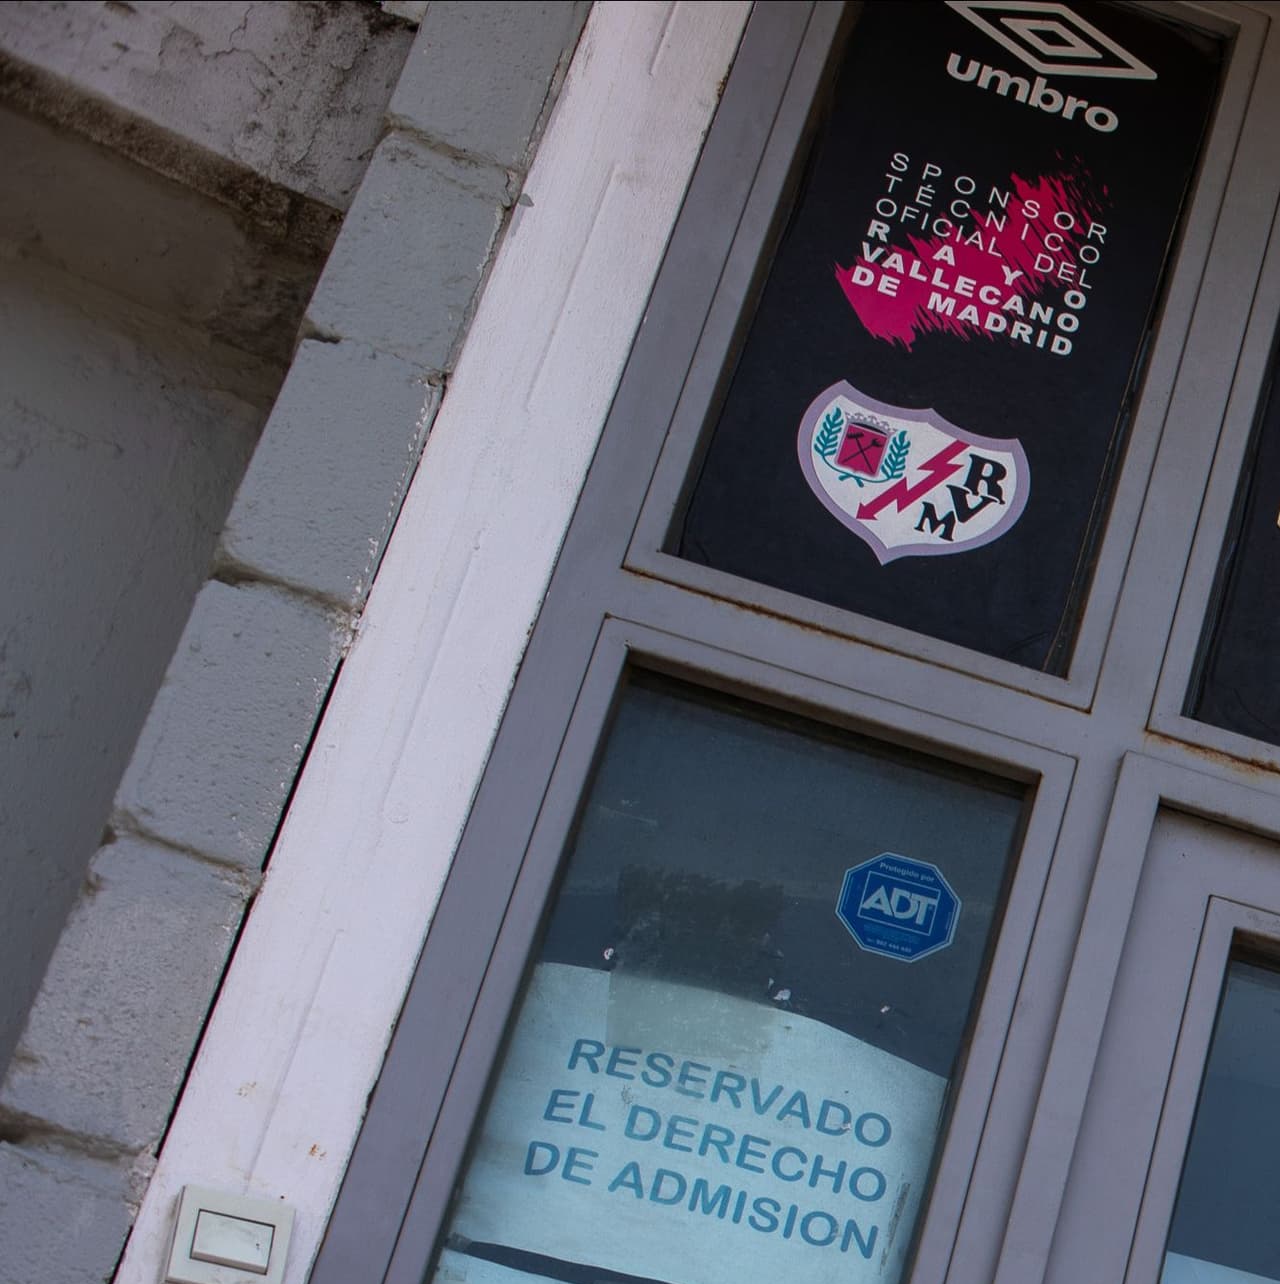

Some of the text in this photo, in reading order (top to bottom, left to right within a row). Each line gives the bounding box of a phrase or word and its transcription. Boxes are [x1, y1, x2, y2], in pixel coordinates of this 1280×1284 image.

[946, 53, 1118, 132] umbro
[884, 174, 1101, 264] TÉCNICO
[890, 152, 1107, 243] SPONSOR
[861, 242, 1079, 333] VALLECANO
[867, 219, 1086, 310] RAYO
[876, 198, 1092, 288] OFICIAL DEL
[851, 267, 1073, 357] DE MADRID
[862, 885, 938, 925] ADT
[880, 862, 935, 883] Protegido por
[567, 1038, 892, 1148] RESERVADO
[543, 1088, 887, 1202] EL DERECHO
[523, 1141, 879, 1260] DE ADMISION
